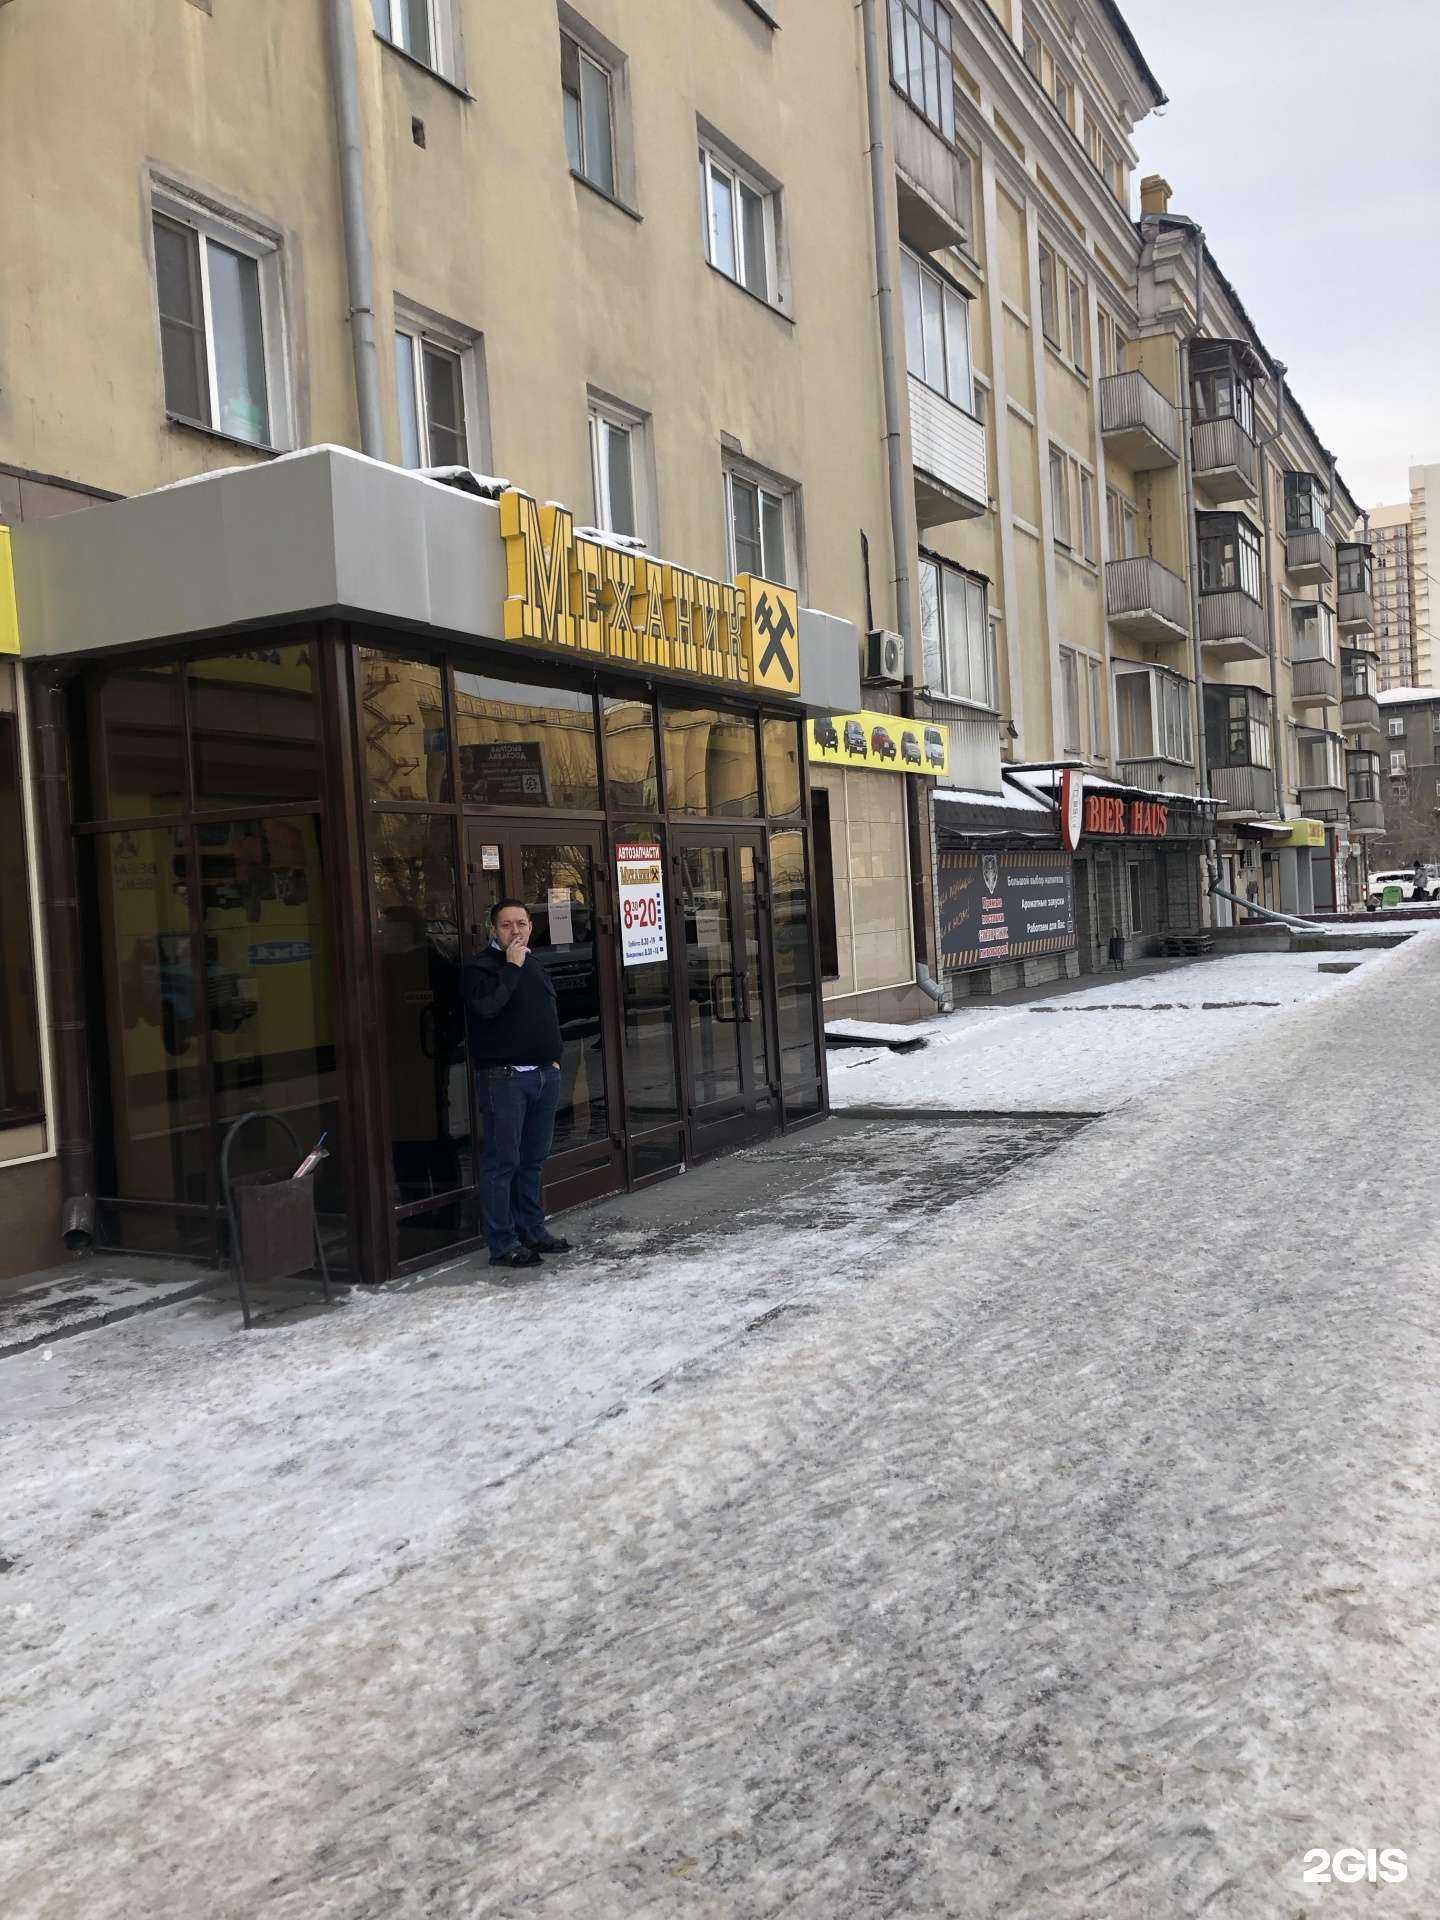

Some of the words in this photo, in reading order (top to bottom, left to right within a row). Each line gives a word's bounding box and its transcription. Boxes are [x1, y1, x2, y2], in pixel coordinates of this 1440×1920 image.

[1086, 795, 1125, 834] BIER
[1129, 801, 1168, 837] HAUS
[618, 846, 660, 860] АВТОЗАПЧАСТИ
